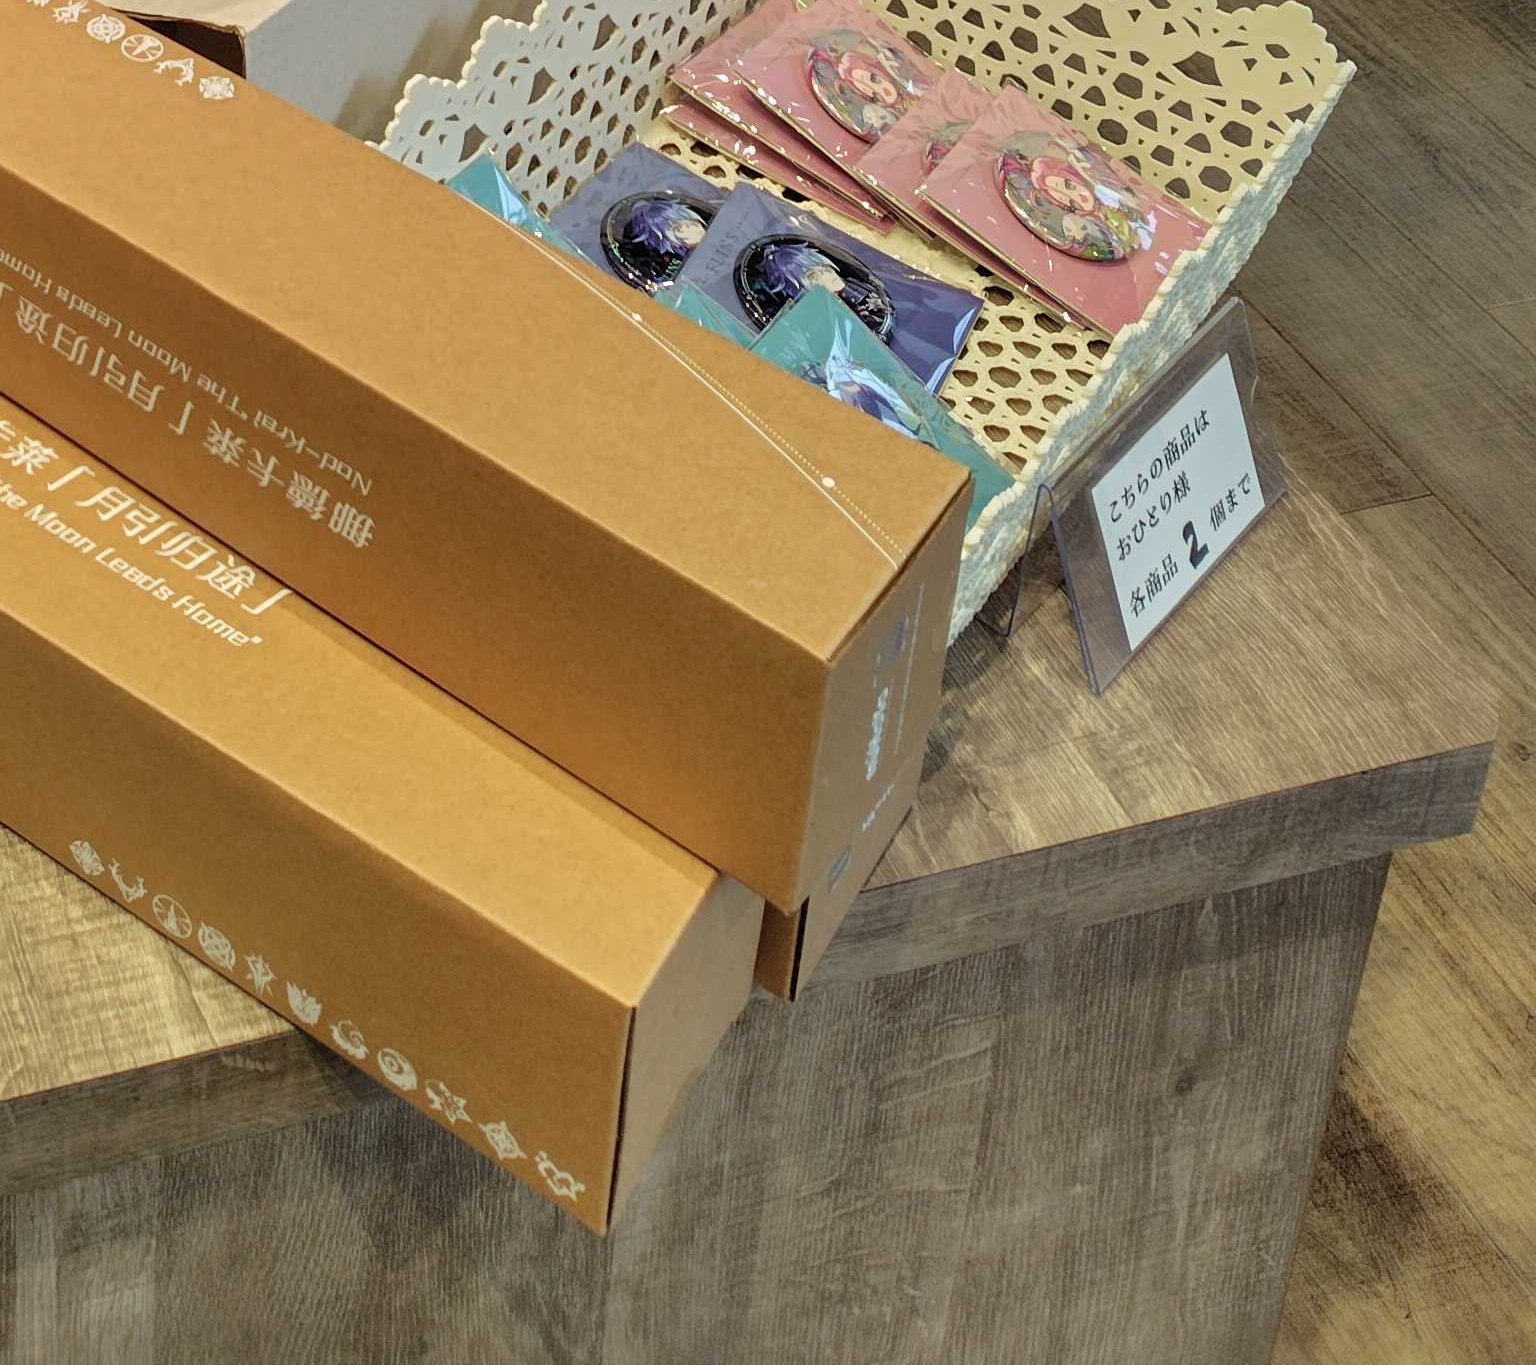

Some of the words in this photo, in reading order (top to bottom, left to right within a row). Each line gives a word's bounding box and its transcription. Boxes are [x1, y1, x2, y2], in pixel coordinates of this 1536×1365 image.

[57, 288, 122, 339] Leads
[128, 328, 193, 384] Moon
[253, 412, 373, 497] Nod-Krai
[1108, 408, 1211, 524] こちらの商品は
[24, 502, 97, 554] Moon
[95, 546, 175, 602] Leads
[1116, 469, 1192, 562] おひとり様
[1128, 552, 1180, 619] 各商品
[1182, 520, 1210, 570] 2
[1208, 472, 1253, 532] 個まで
